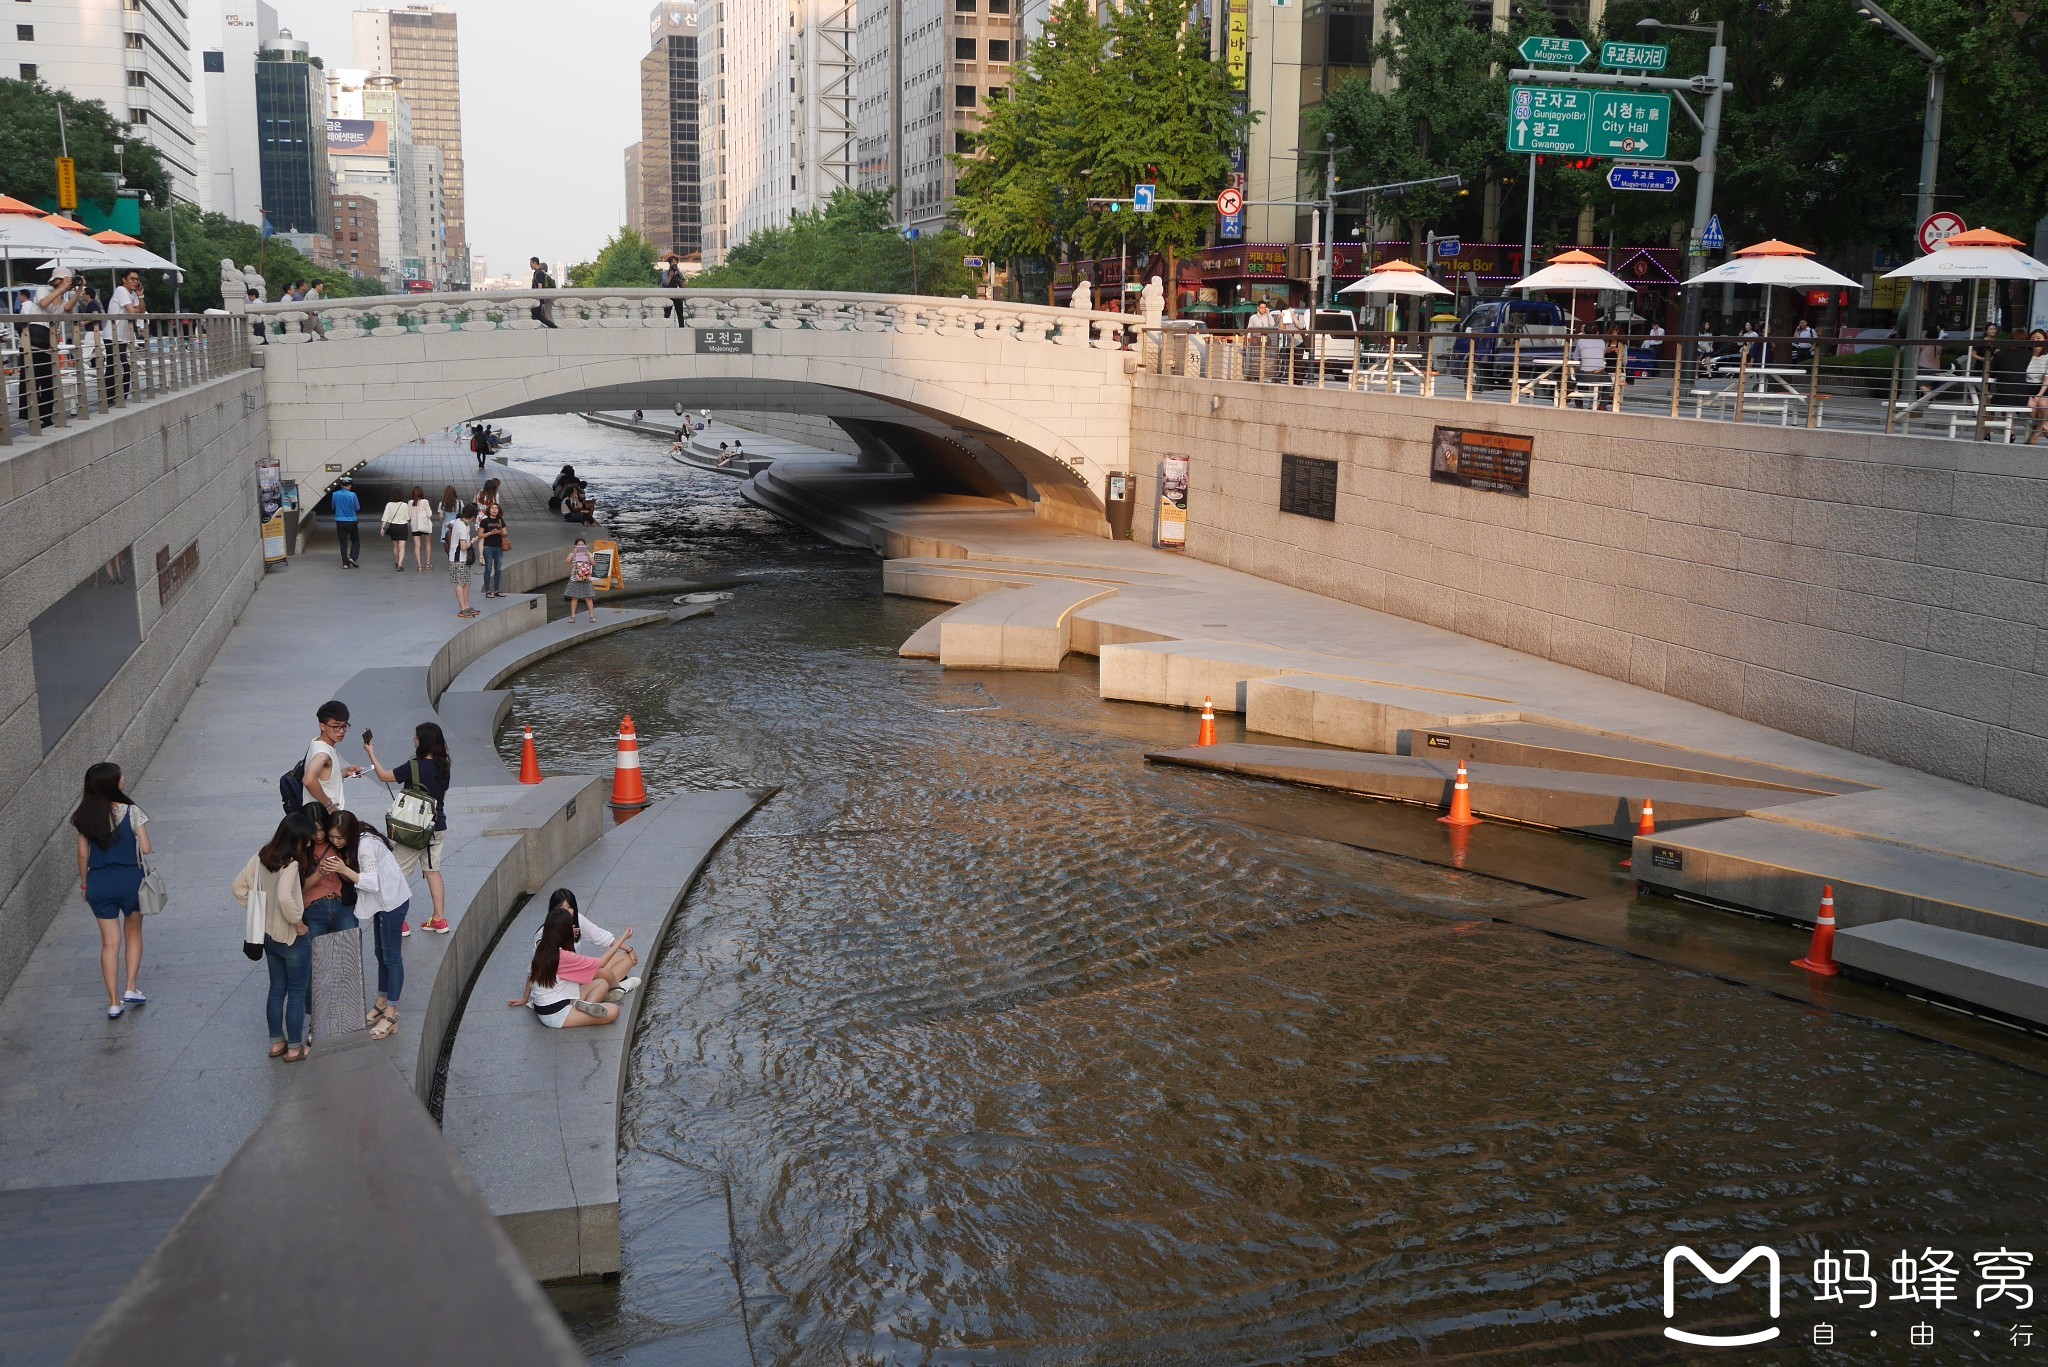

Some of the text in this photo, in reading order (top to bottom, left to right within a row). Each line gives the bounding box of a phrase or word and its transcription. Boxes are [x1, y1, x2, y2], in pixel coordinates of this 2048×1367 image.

[1541, 39, 1570, 51] 무교로
[1535, 50, 1574, 61] Mugyo-ro
[1607, 46, 1663, 66] 무교동사거리
[1519, 95, 1529, 104] 61
[1534, 91, 1577, 109] 군자교
[1516, 107, 1528, 118] 50
[1533, 109, 1586, 121] Gunjagyo(Br)
[1603, 101, 1633, 119] 시청
[1532, 121, 1560, 137] 광교
[1602, 120, 1649, 135] City Hall
[1531, 139, 1575, 151] Gwanggyo
[1612, 174, 1622, 182] 37
[1632, 170, 1655, 180] 무교로
[1665, 176, 1674, 184] 33
[1249, 252, 1264, 262] 커피
[1453, 258, 1470, 271] Ice
[1473, 258, 1495, 271] Bar
[704, 331, 744, 345] 모전교
[709, 345, 739, 353] Mojeongyo
